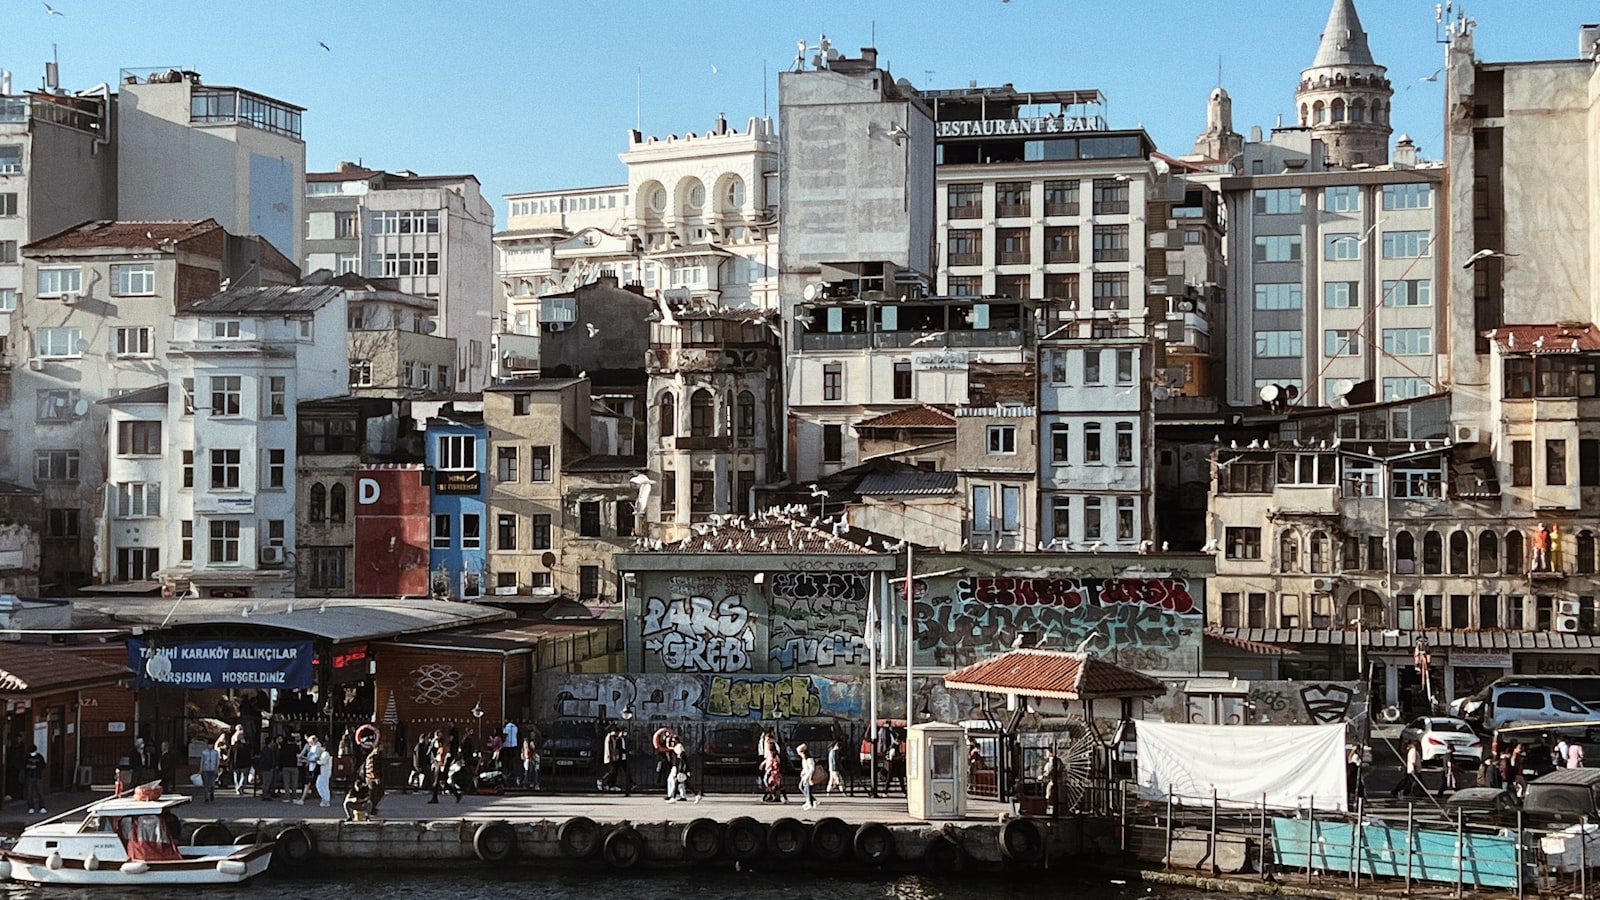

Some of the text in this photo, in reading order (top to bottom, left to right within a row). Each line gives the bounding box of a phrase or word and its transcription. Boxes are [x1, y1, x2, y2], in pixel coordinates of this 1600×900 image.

[1046, 117, 1059, 133] &
[1062, 116, 1098, 132] BAR
[359, 478, 380, 505] D
[642, 595, 748, 639] PARS
[181, 646, 230, 660] KARAKÖY
[232, 648, 297, 661] BALIKÇILAR
[151, 671, 212, 685] RŞISINA
